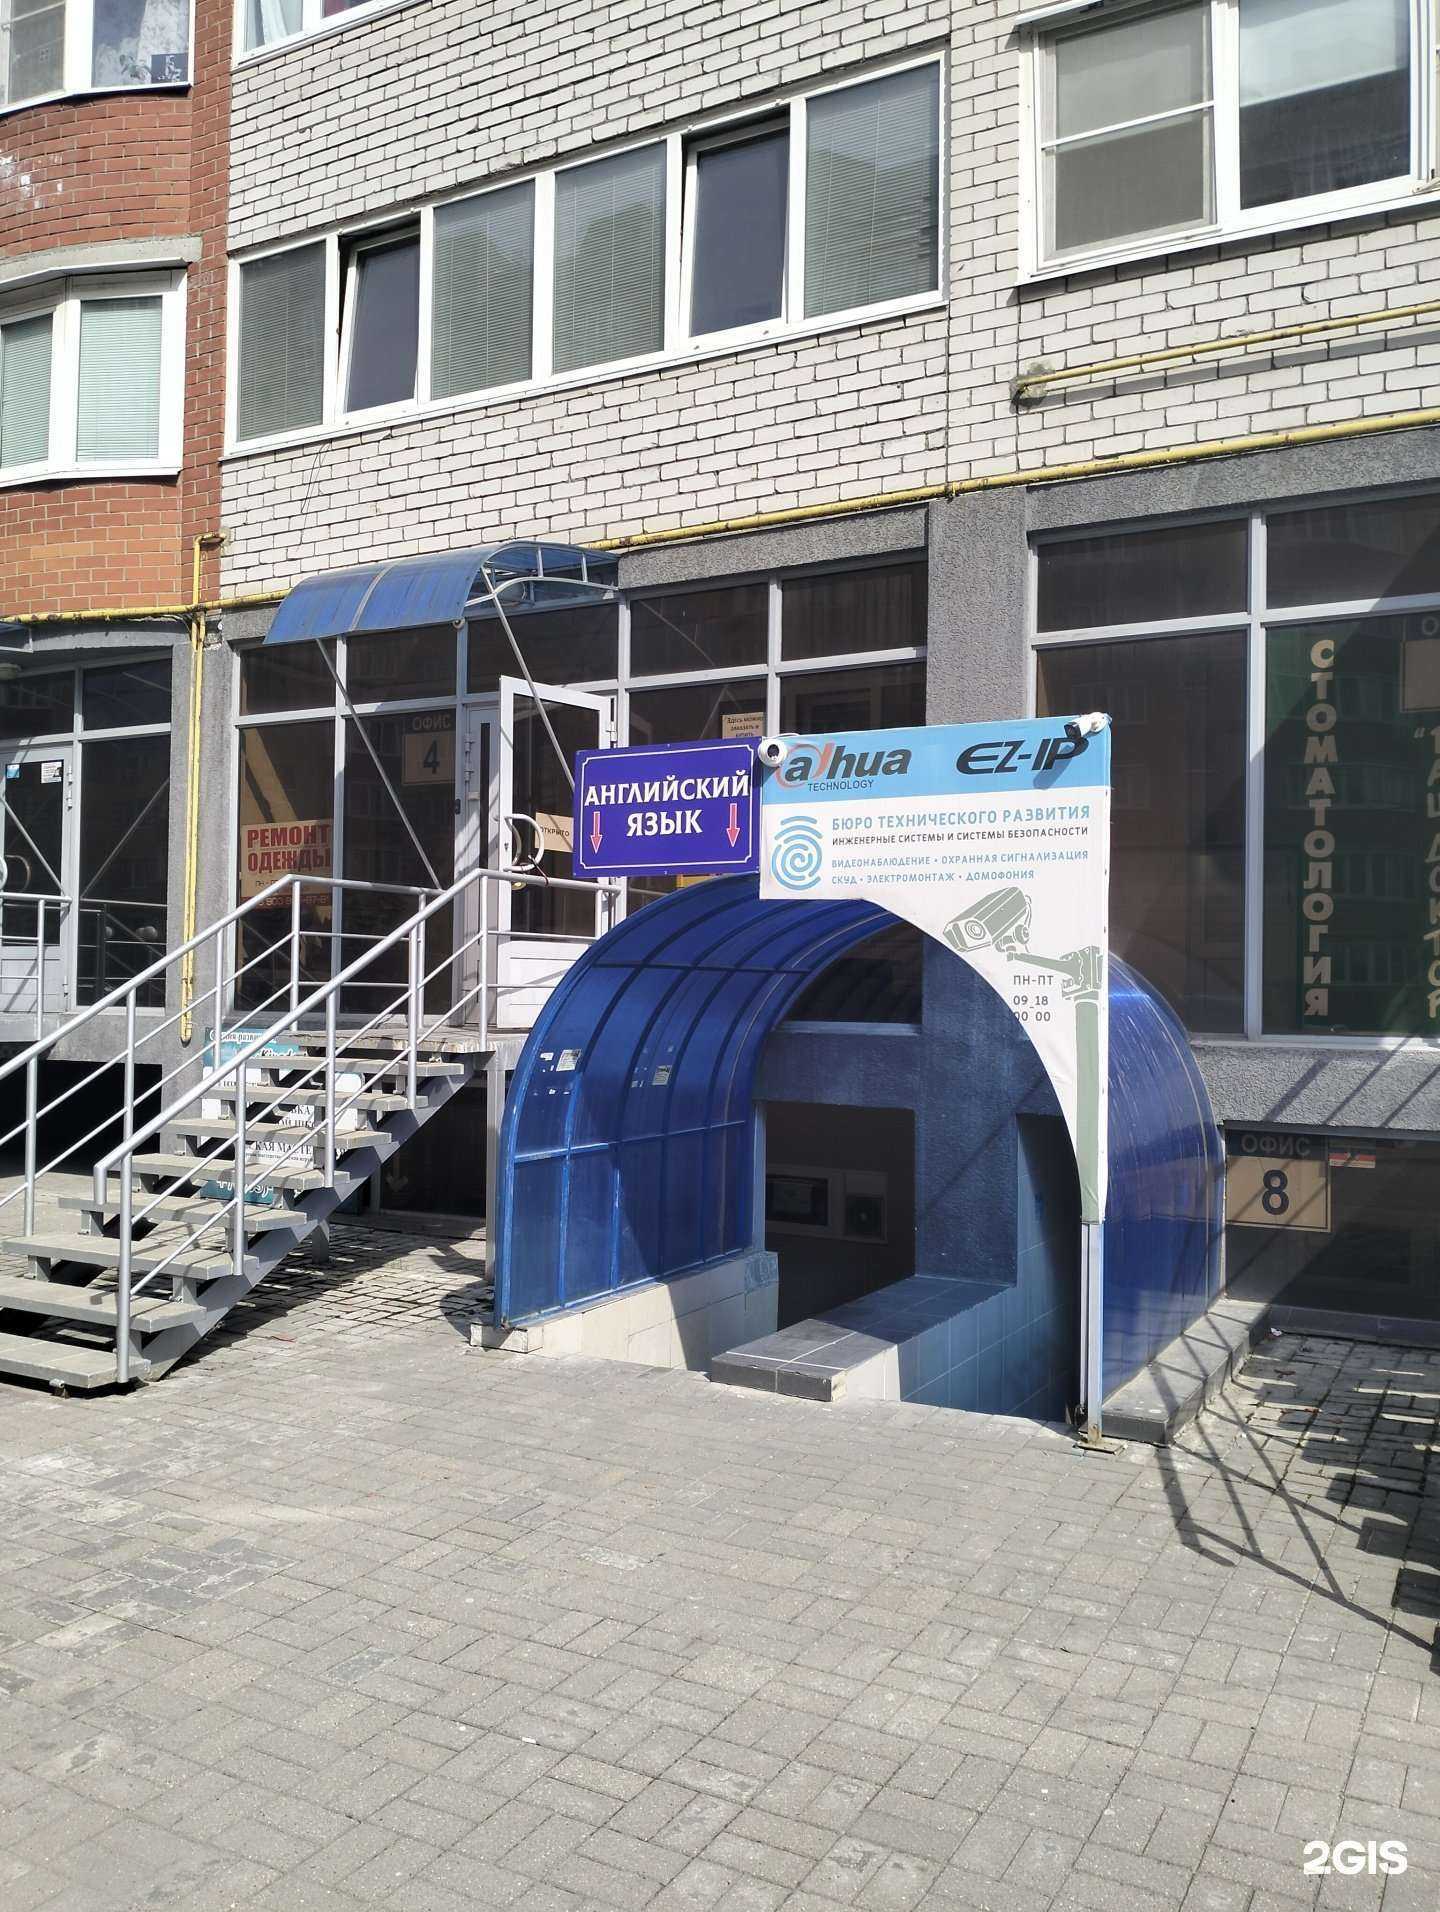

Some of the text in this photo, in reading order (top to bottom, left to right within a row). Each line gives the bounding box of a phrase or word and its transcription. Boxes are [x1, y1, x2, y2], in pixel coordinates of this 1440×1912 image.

[412, 714, 450, 731] ОФИС
[423, 739, 440, 775] 4
[584, 769, 750, 806] АНГЛИЙСКИЙ
[807, 779, 874, 792] TECHNOLOGY
[626, 809, 703, 837] ЯЗЫК
[832, 805, 1090, 831] БЮРО ТЕХНИЧЕСКОГО РАЗВИТИЯ
[1303, 639, 1339, 1017] СТОМАТОЛОГИЯ
[247, 824, 331, 849] РЕМОНТ
[832, 826, 1088, 846] ИНЖЕНЕРНЫЕ СИСТЕМЫ И СИСТЕМЫ БЕЗОПАСНОСТИ
[247, 848, 331, 874] ОДЕЖДЫ
[832, 850, 1088, 868] ВИДЕОНАБЛЮДЕНИЕ ОХРАННАЯ СИГНАЛИЗАЦИЯ
[831, 869, 1035, 885] СКУД ЭЛЕКТРОМОНТАЖ ДОМОФОНИЯ
[1241, 1134, 1312, 1156] ОФИС
[1262, 1169, 1290, 1216] 8
